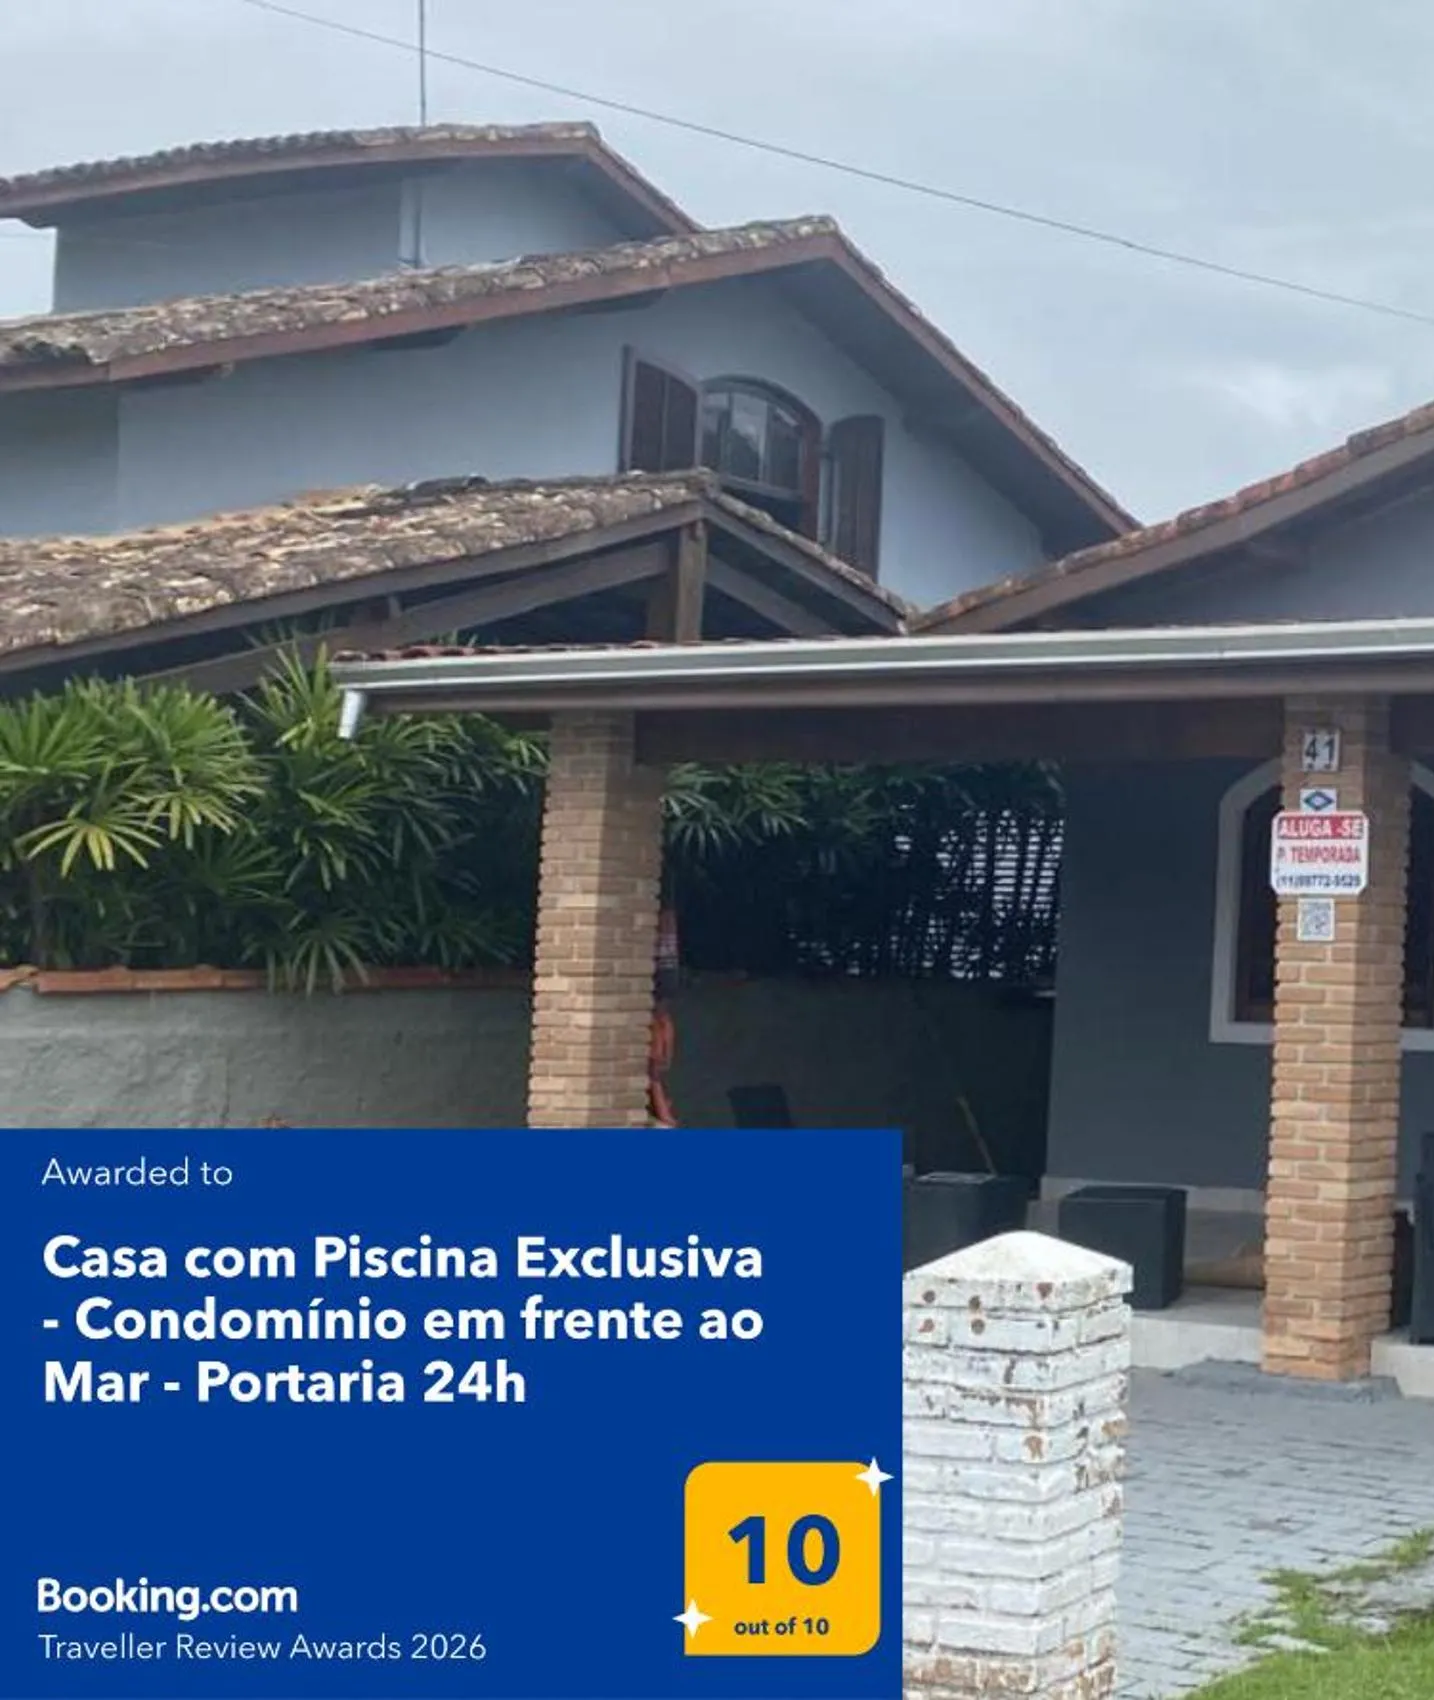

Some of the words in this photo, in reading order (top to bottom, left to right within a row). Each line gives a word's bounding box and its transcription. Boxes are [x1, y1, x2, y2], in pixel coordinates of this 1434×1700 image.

[1305, 736, 1335, 763] 41
[1280, 819, 1332, 836] ALUGA
[1291, 846, 1360, 863] TEMPORADA
